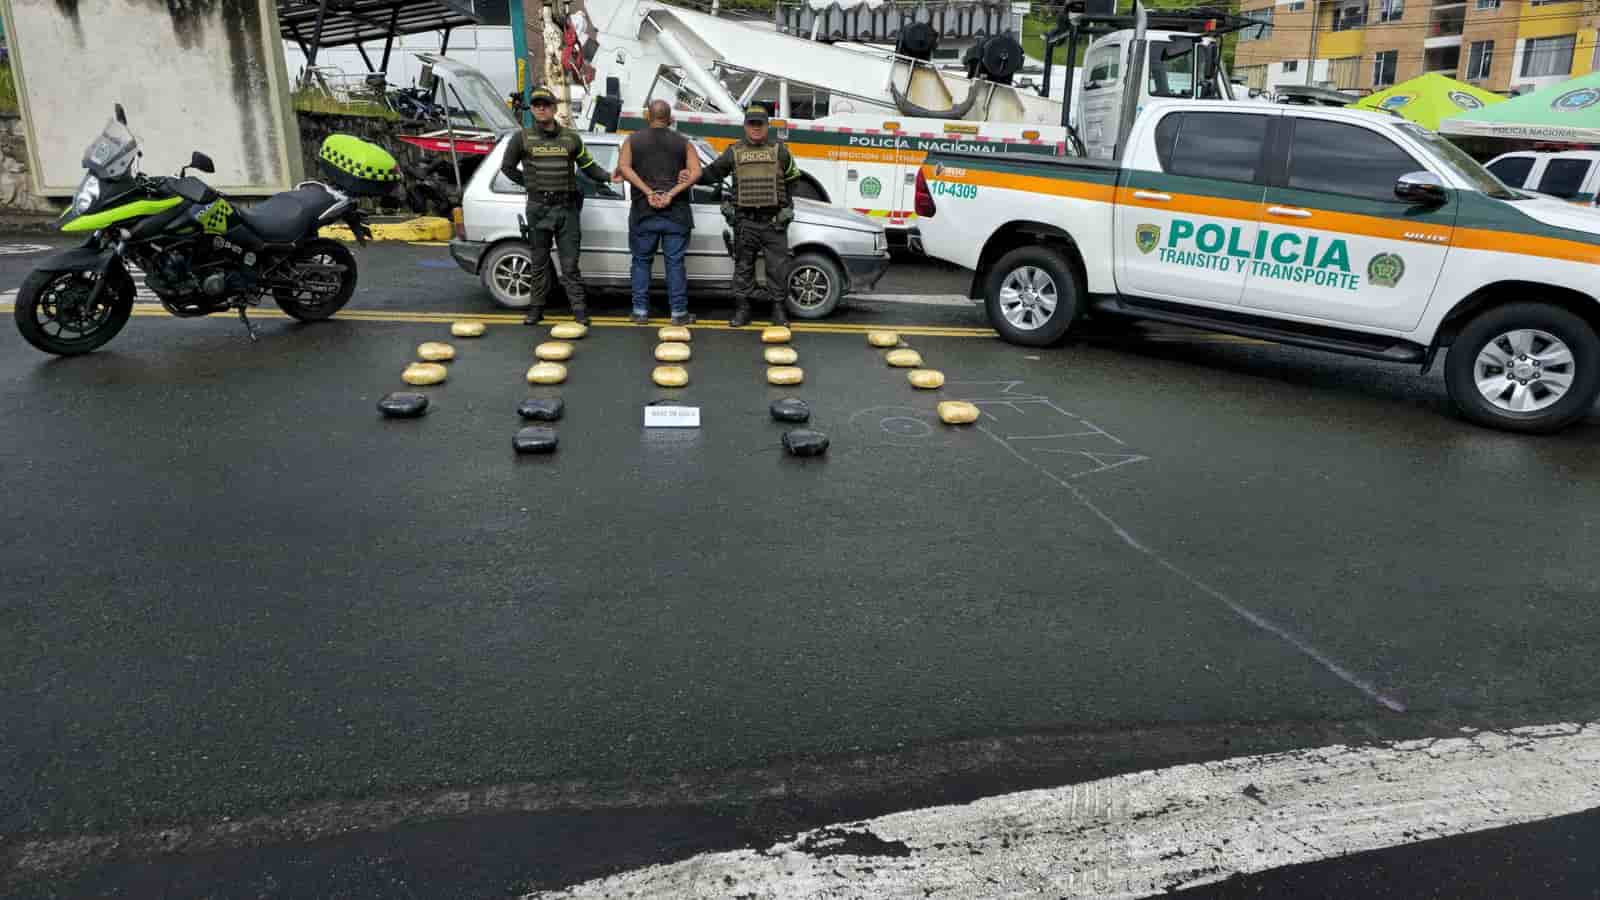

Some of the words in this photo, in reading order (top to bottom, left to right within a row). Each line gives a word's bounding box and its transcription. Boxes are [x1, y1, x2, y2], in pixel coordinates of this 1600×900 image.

[1530, 128, 1577, 138] NACIONAL
[931, 181, 977, 199] 10-4309
[1167, 219, 1351, 272] POLICIA
[1159, 247, 1230, 273] TRANSITO
[1236, 258, 1246, 273] Y
[1250, 260, 1361, 290] TRANSPORTE
